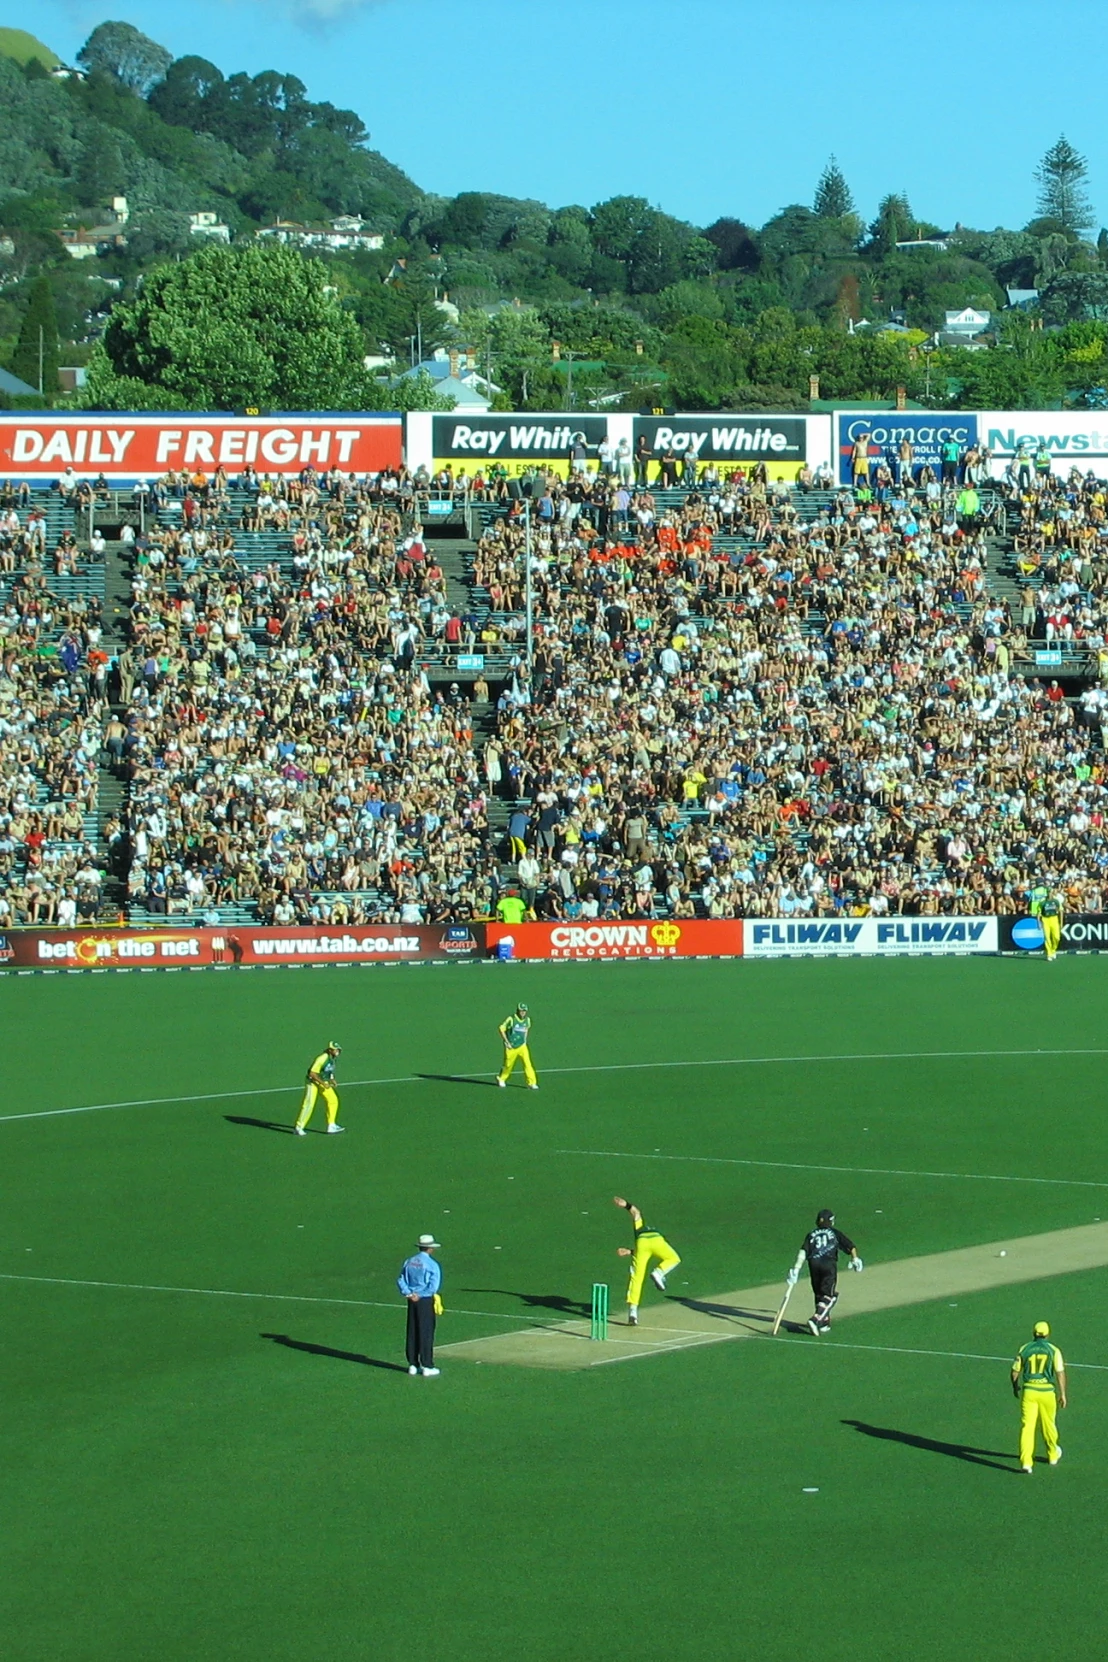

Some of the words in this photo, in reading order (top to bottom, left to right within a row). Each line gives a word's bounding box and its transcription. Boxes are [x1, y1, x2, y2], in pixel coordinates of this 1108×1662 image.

[245, 408, 259, 416] 120
[451, 425, 506, 454] Ray
[653, 427, 708, 456] Ray
[711, 428, 787, 451] White
[848, 420, 968, 444] Comacc
[12, 429, 135, 463] DAILY
[155, 428, 360, 464] FREIGHT
[550, 926, 647, 948] CROWN
[753, 924, 864, 944] FLIWAY
[877, 921, 987, 943] FLIWAY
[38, 940, 76, 957] bet
[118, 938, 155, 956] the
[161, 938, 200, 956] net
[252, 934, 420, 954] www.tab.co.nz
[551, 947, 677, 957] RELOCATIONS
[1028, 1353, 1048, 1375] 17
